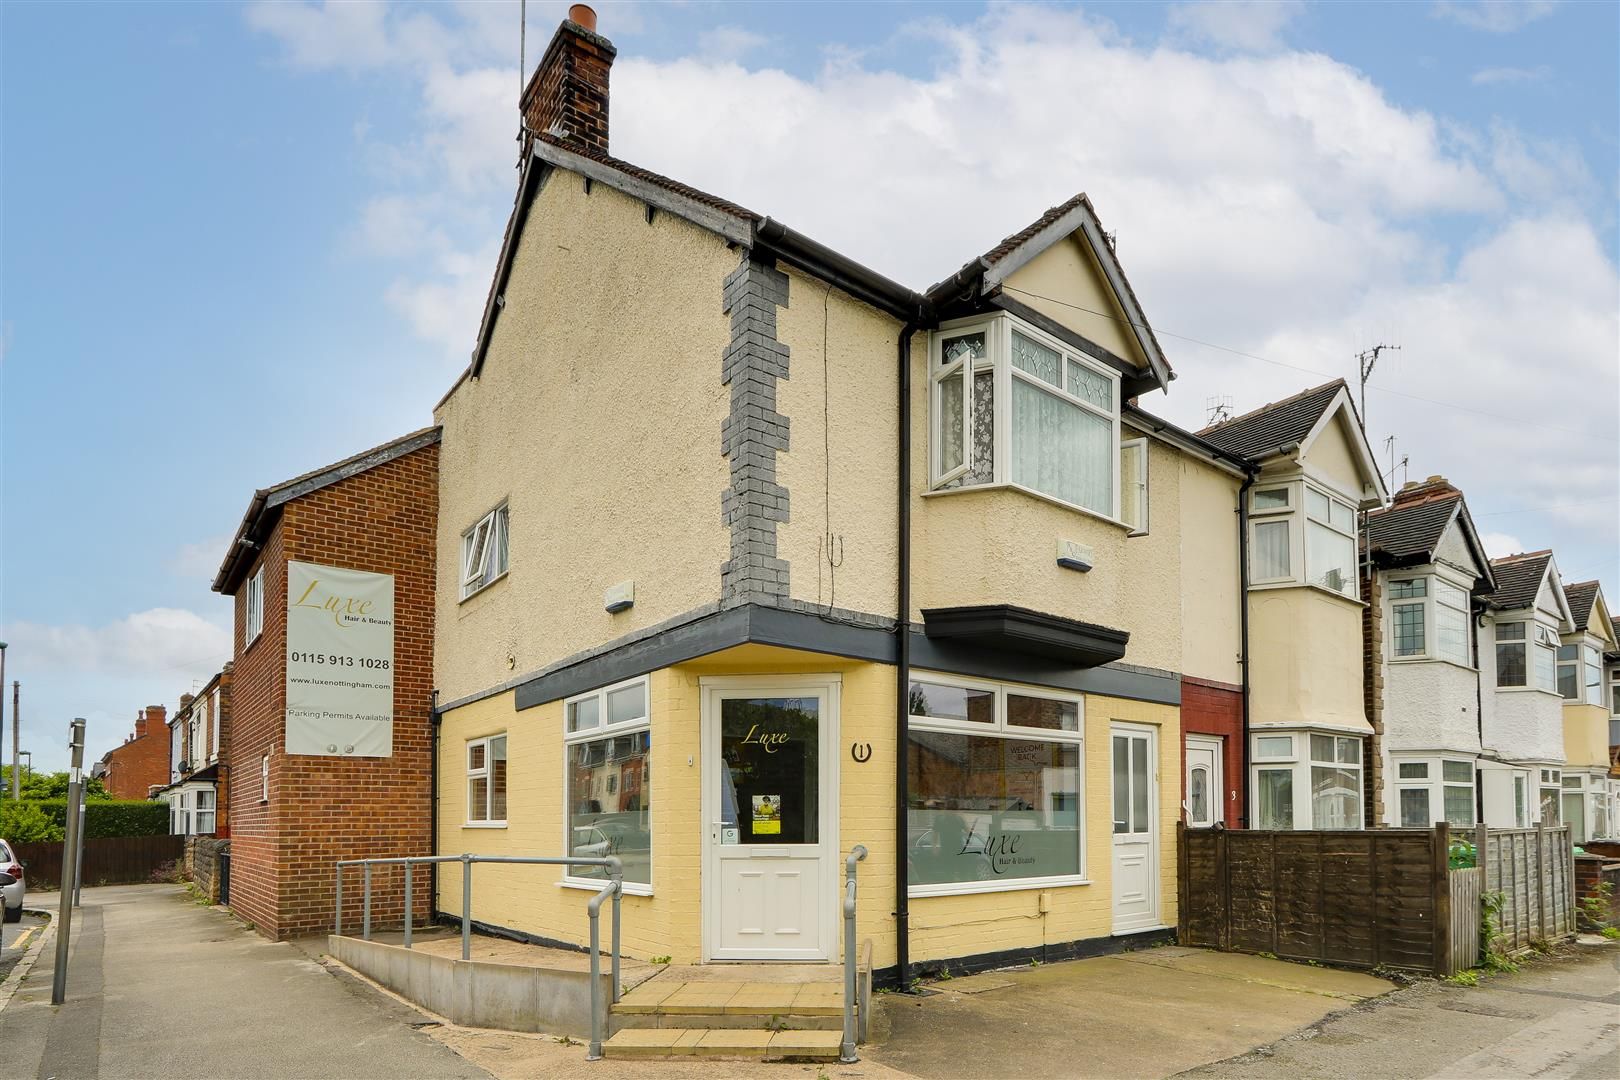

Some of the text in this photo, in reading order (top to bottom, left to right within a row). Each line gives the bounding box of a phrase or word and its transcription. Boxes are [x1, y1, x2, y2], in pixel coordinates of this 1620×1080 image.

[290, 579, 376, 627] Luxe
[344, 615, 360, 623] Hair
[368, 618, 392, 626] Beauty
[291, 651, 390, 670] 0115 913 1028
[290, 678, 391, 690] www.luxenottingham.com
[288, 709, 391, 722] Parking Permits Available
[741, 724, 790, 753] Luxe
[1231, 790, 1236, 801] 3
[956, 816, 1023, 874] Luxe
[999, 857, 1011, 865] Hair
